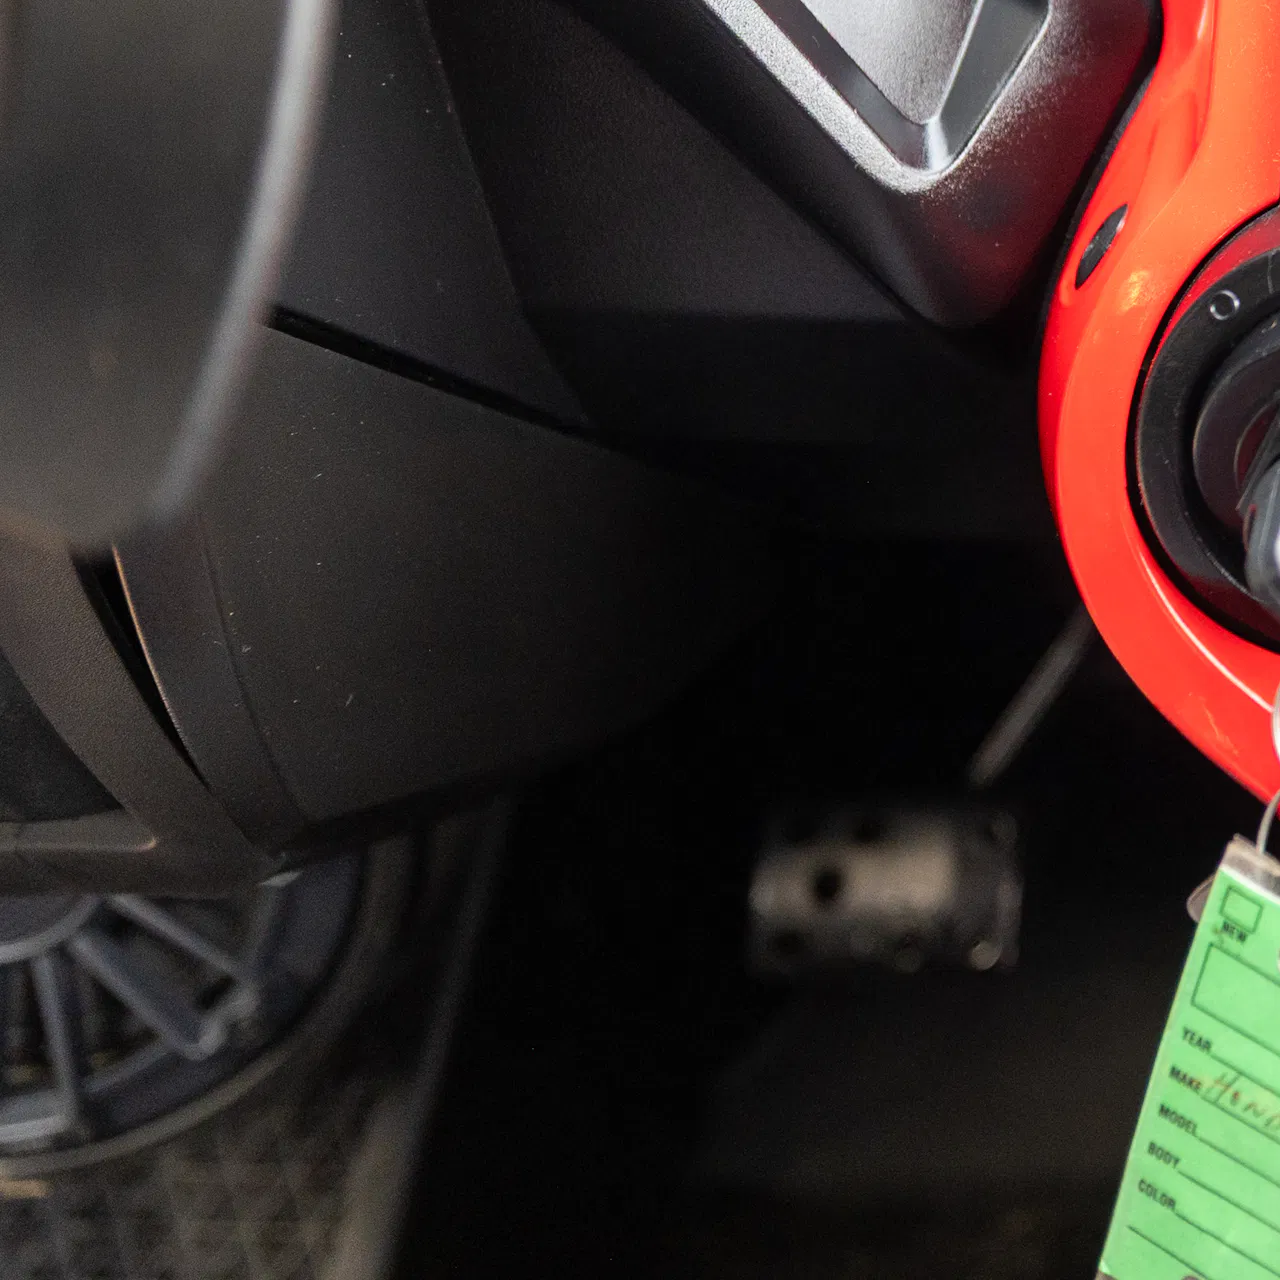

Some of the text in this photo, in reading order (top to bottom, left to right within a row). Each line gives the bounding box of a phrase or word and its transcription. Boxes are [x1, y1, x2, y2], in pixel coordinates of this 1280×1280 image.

[1182, 1026, 1213, 1053] YEAR
[1168, 1065, 1203, 1094] MAKE
[1158, 1103, 1199, 1137] MODEL
[1147, 1141, 1181, 1169] BODY
[1138, 1178, 1178, 1211] COLOR
